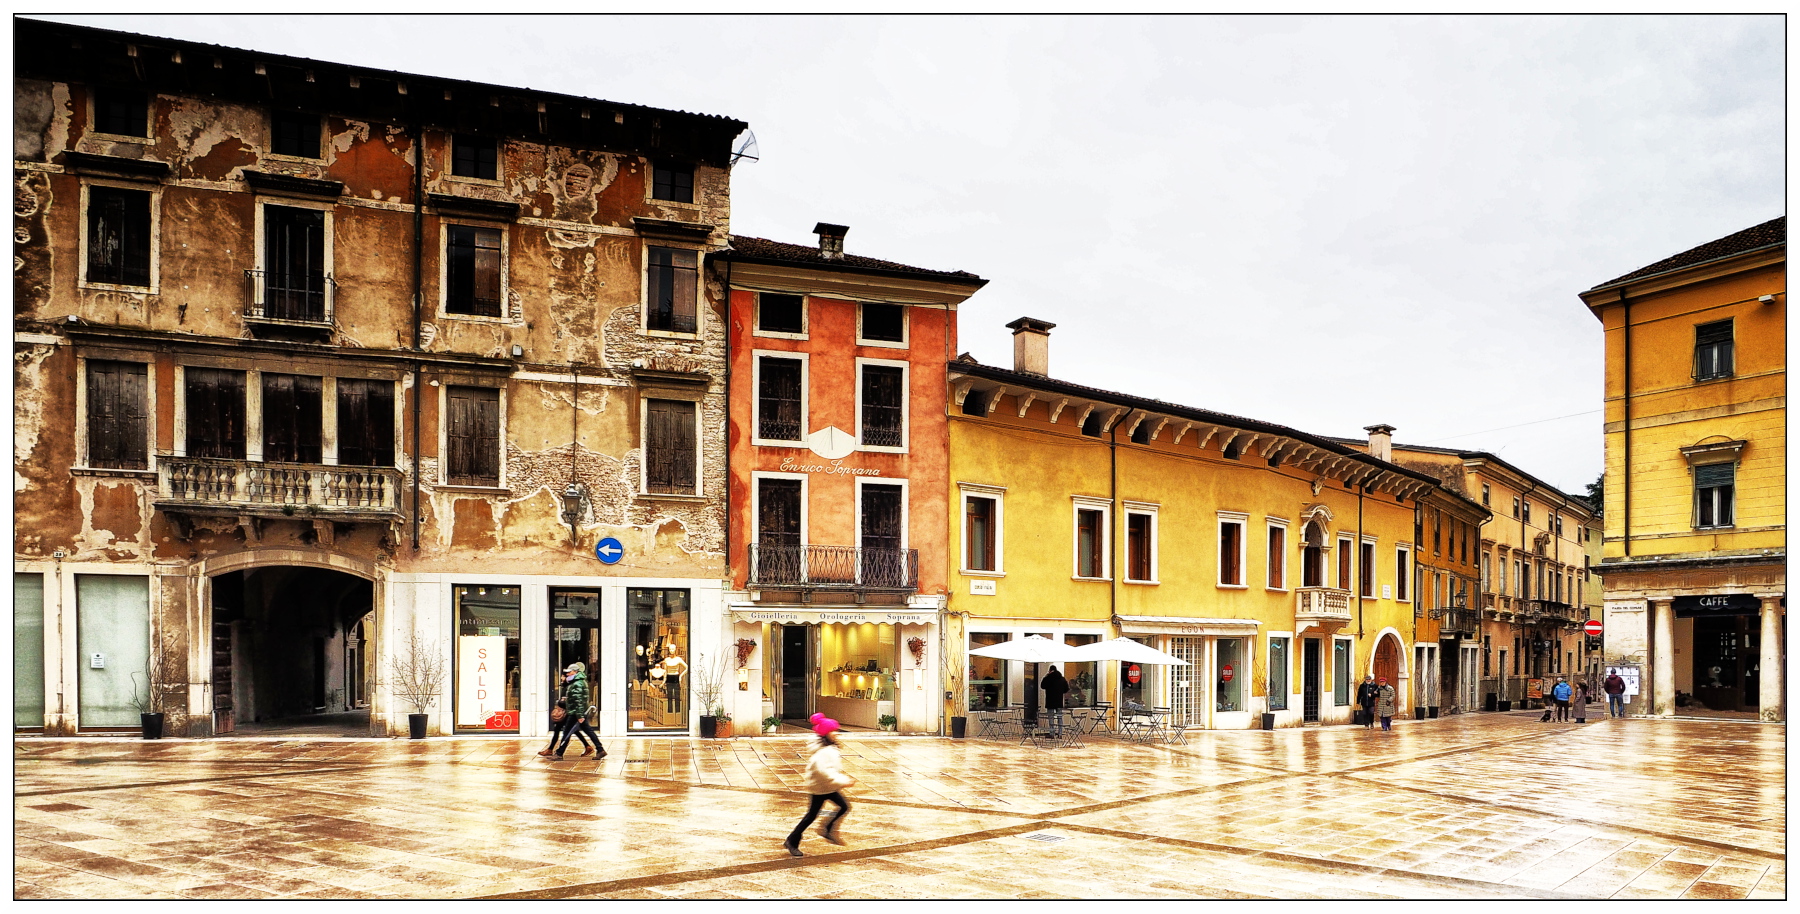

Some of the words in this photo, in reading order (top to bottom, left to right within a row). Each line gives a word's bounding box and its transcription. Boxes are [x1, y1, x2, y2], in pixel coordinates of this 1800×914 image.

[780, 457, 823, 472] Enrico
[825, 460, 880, 477] Soprana
[750, 612, 798, 620] Gioielleria
[819, 613, 866, 621] Orologeria
[886, 613, 921, 621] Soprana
[1181, 625, 1205, 634] EGON
[477, 647, 488, 713] SALDI
